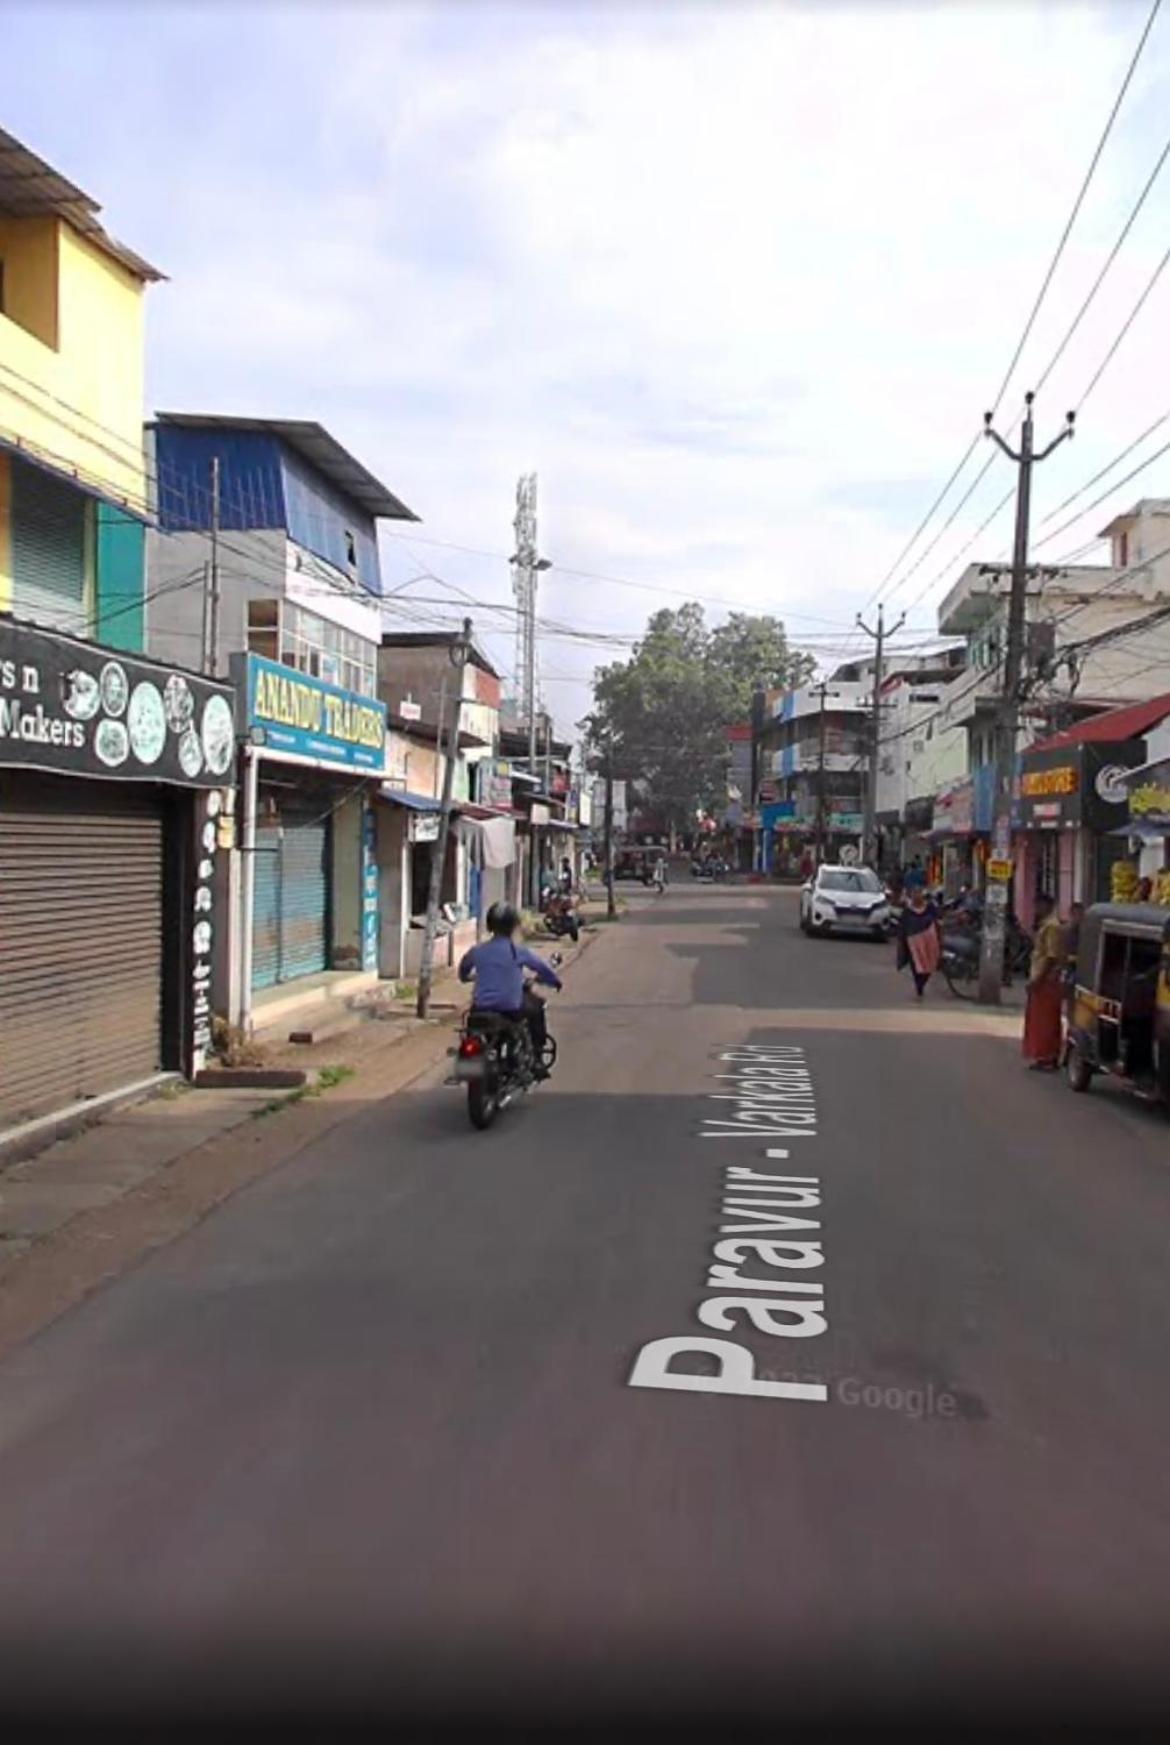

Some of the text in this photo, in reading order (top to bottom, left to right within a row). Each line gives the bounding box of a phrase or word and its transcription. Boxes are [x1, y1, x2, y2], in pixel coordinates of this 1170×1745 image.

[22, 665, 39, 693] n
[0, 697, 86, 748] Makers
[254, 669, 383, 749] ANANDU TRADERS
